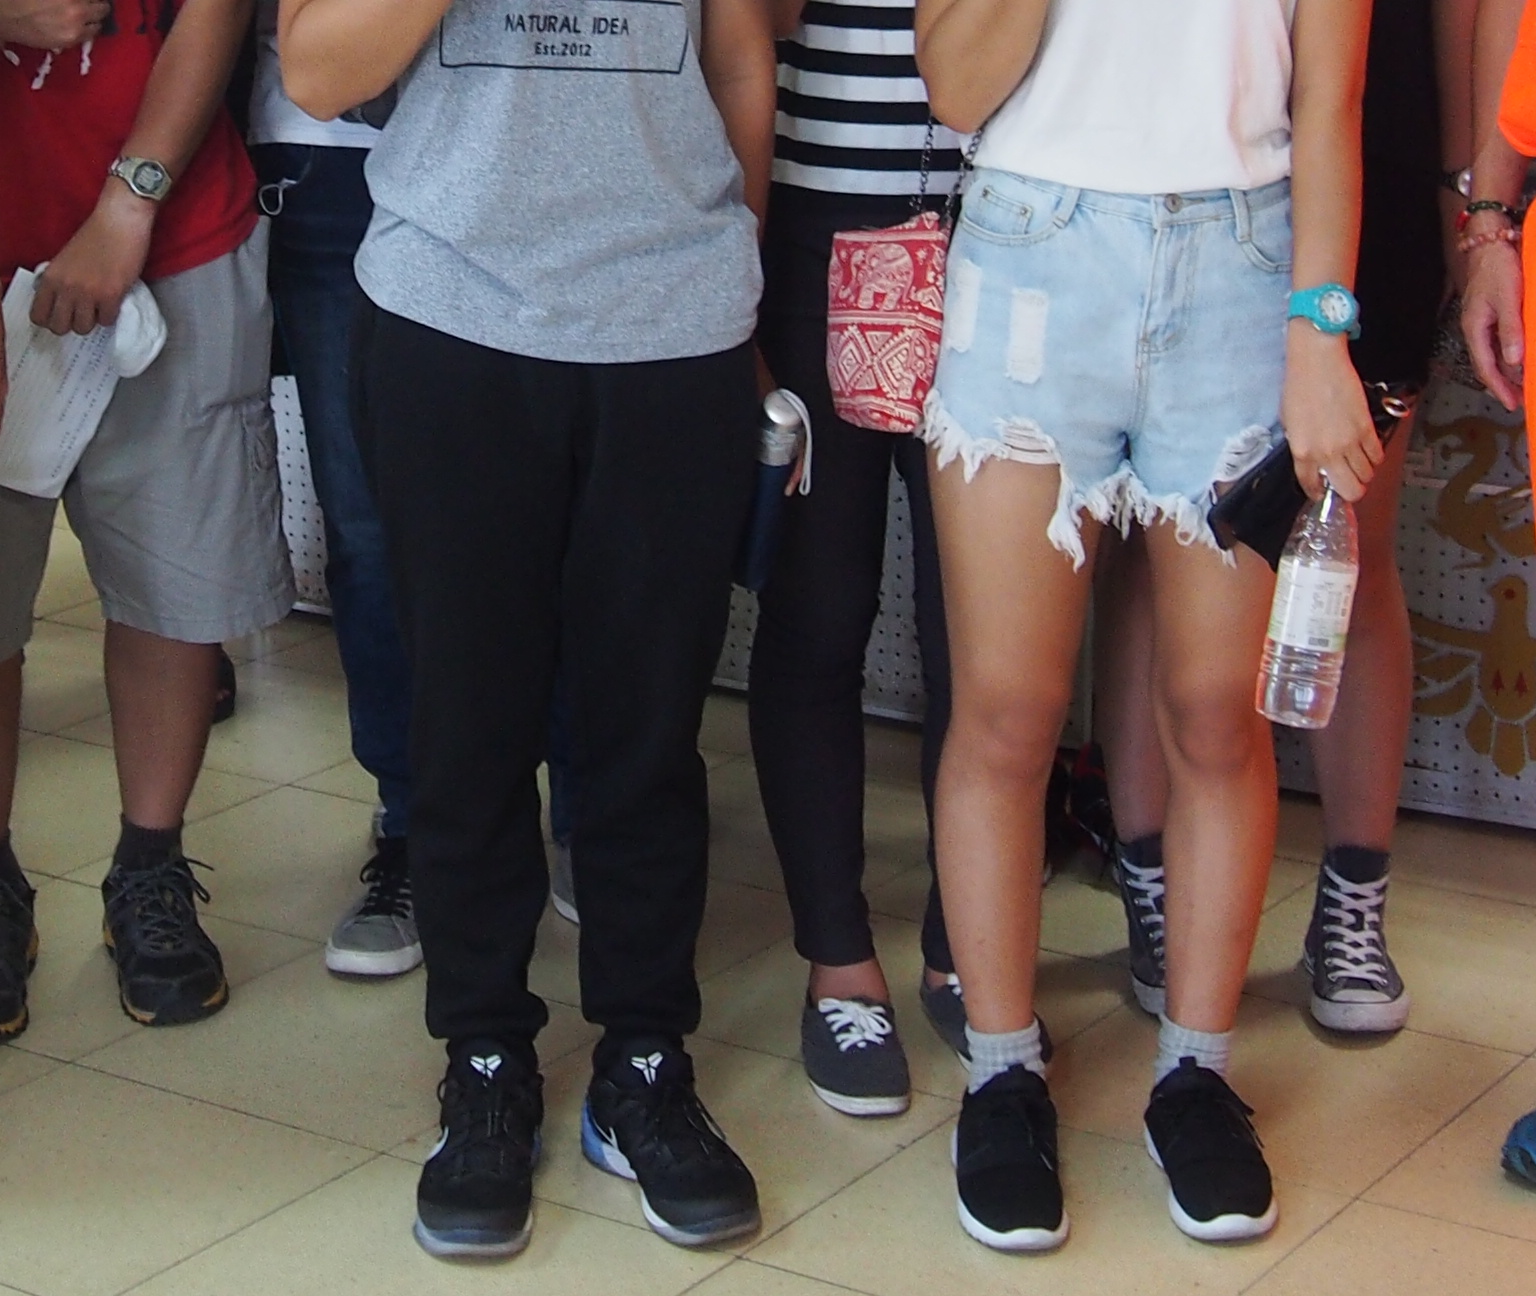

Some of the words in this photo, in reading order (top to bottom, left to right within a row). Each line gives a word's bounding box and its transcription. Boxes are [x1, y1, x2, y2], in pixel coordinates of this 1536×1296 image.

[504, 13, 581, 35] NATURAL
[592, 17, 629, 38] IDEA
[534, 42, 592, 57] Est.2012
